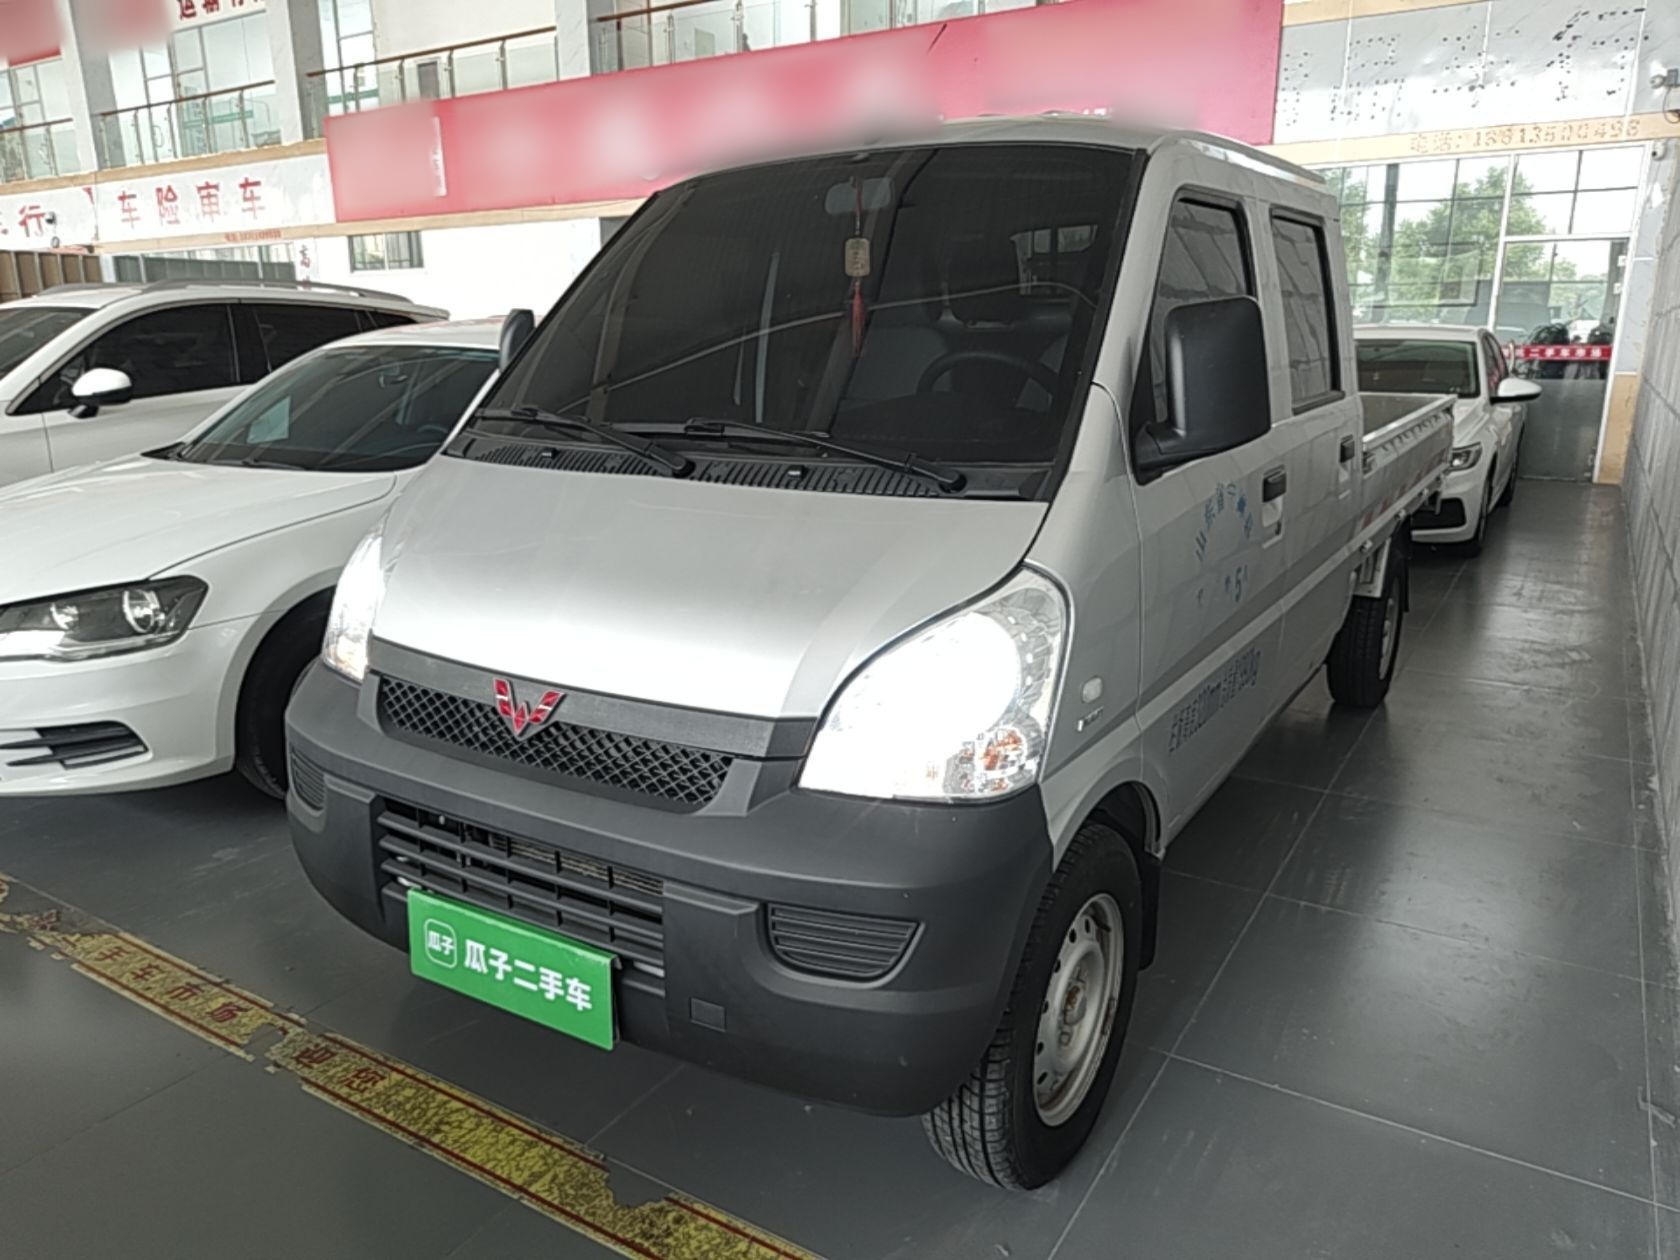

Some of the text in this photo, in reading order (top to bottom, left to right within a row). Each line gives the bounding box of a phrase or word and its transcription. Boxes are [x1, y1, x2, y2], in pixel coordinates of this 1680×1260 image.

[117, 177, 264, 230] 车险审车
[427, 930, 454, 956] 瓜子
[464, 939, 593, 1012] 瓜子二手车
